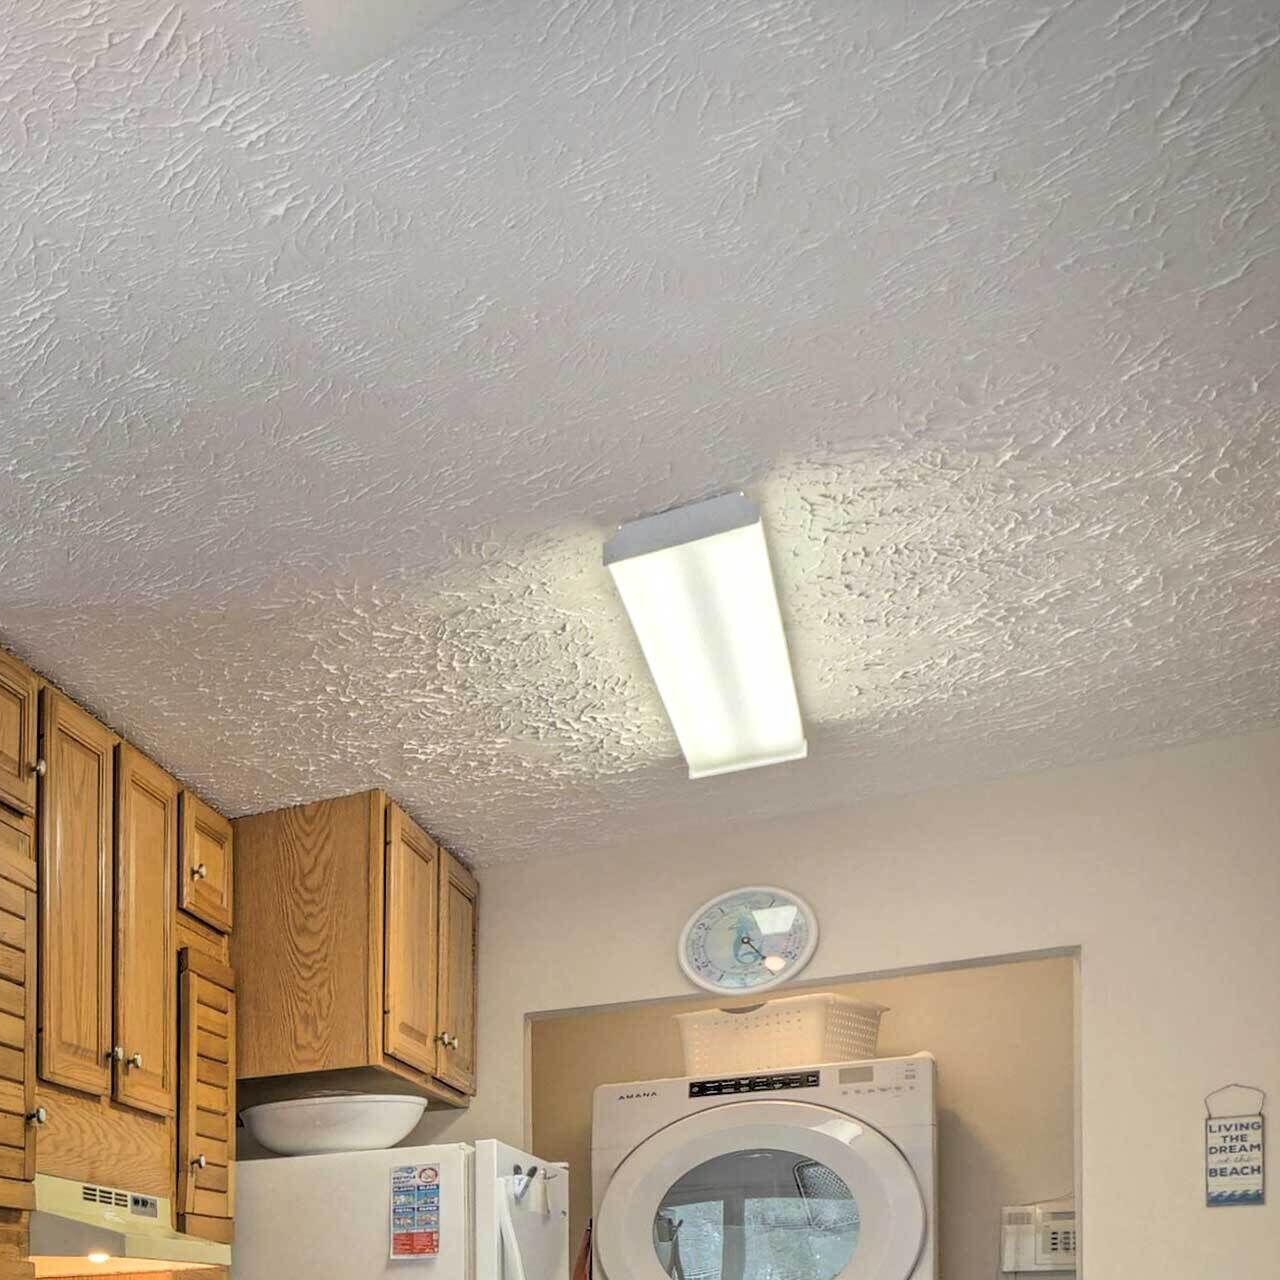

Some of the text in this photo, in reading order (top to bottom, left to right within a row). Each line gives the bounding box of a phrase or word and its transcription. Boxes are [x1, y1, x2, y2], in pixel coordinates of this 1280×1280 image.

[1209, 1122, 1262, 1133] LIVING
[1221, 1134, 1248, 1143] THE
[1209, 1144, 1261, 1154] DREAM
[1209, 1165, 1261, 1177] BEACH
